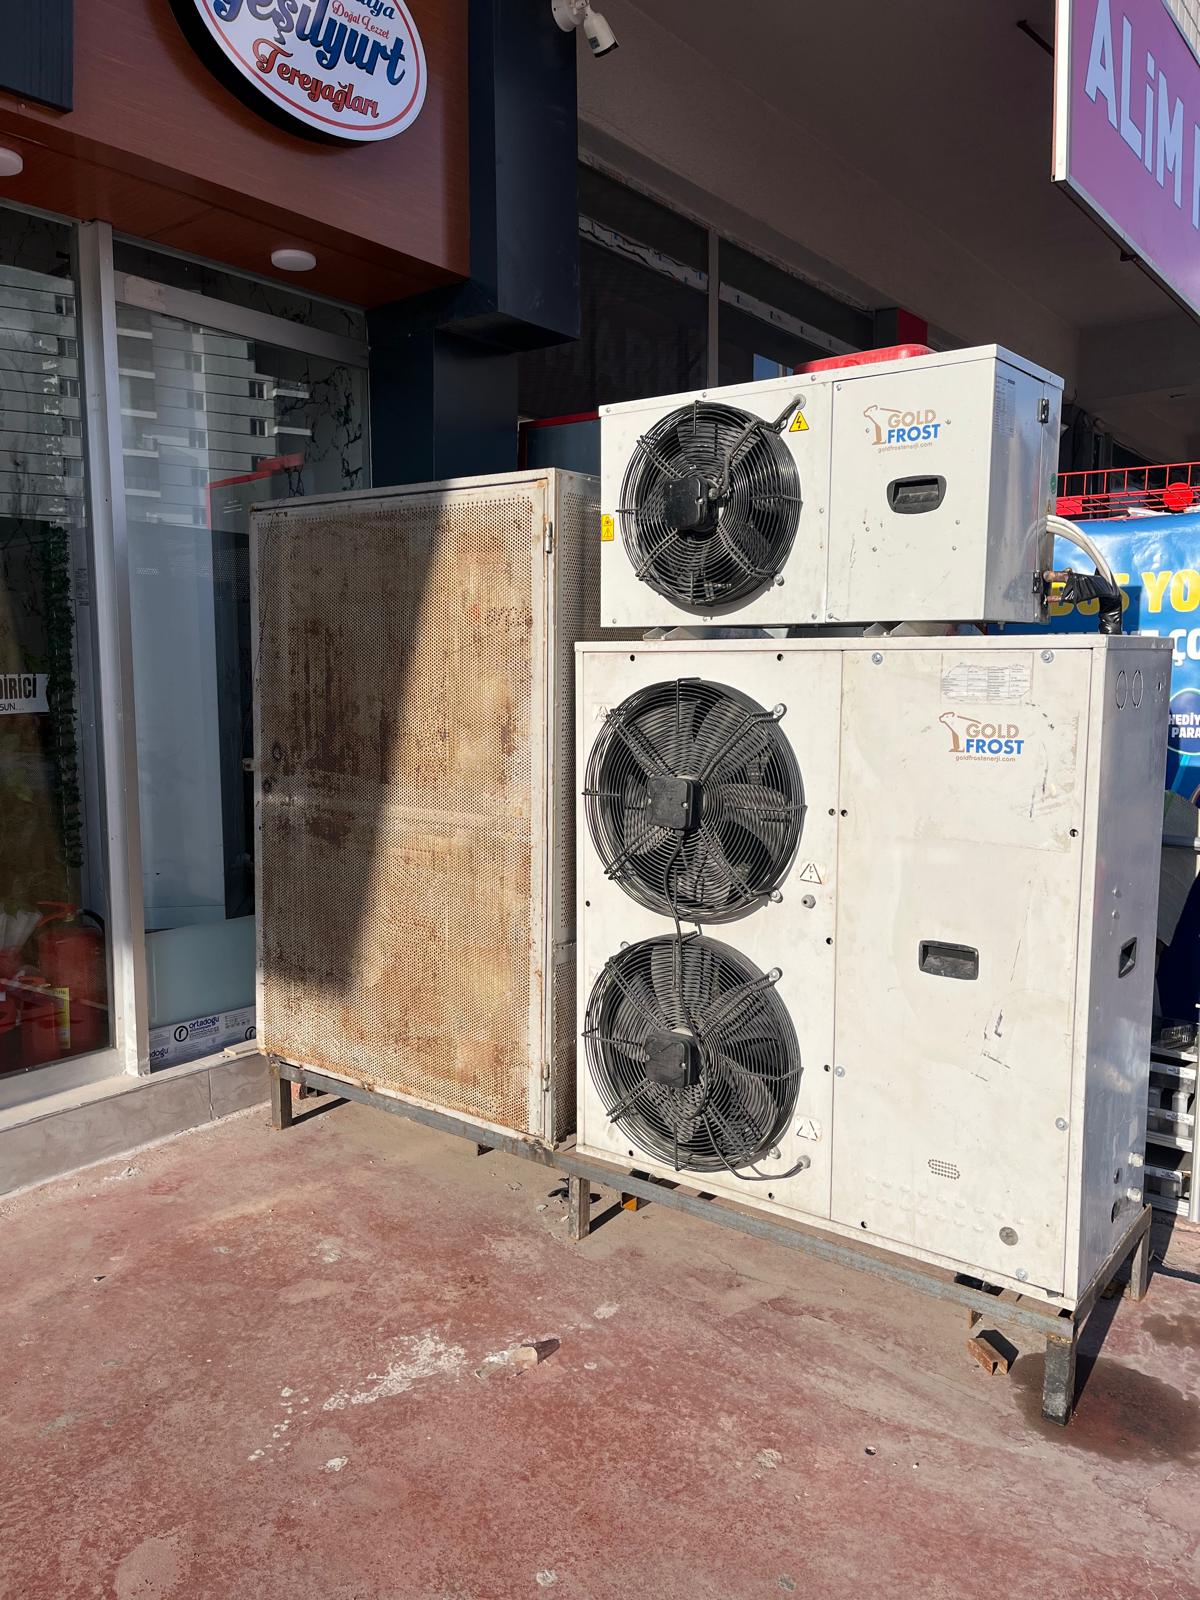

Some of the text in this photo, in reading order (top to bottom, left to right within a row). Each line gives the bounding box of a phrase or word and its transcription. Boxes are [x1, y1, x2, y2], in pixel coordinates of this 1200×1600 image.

[332, 1, 389, 40] Doğal Lezzet
[252, 38, 379, 118] Tereyağları
[888, 409, 937, 428] GOLD
[887, 423, 941, 443] FROST
[965, 723, 1020, 739] GOLD
[965, 738, 1025, 755] FROST
